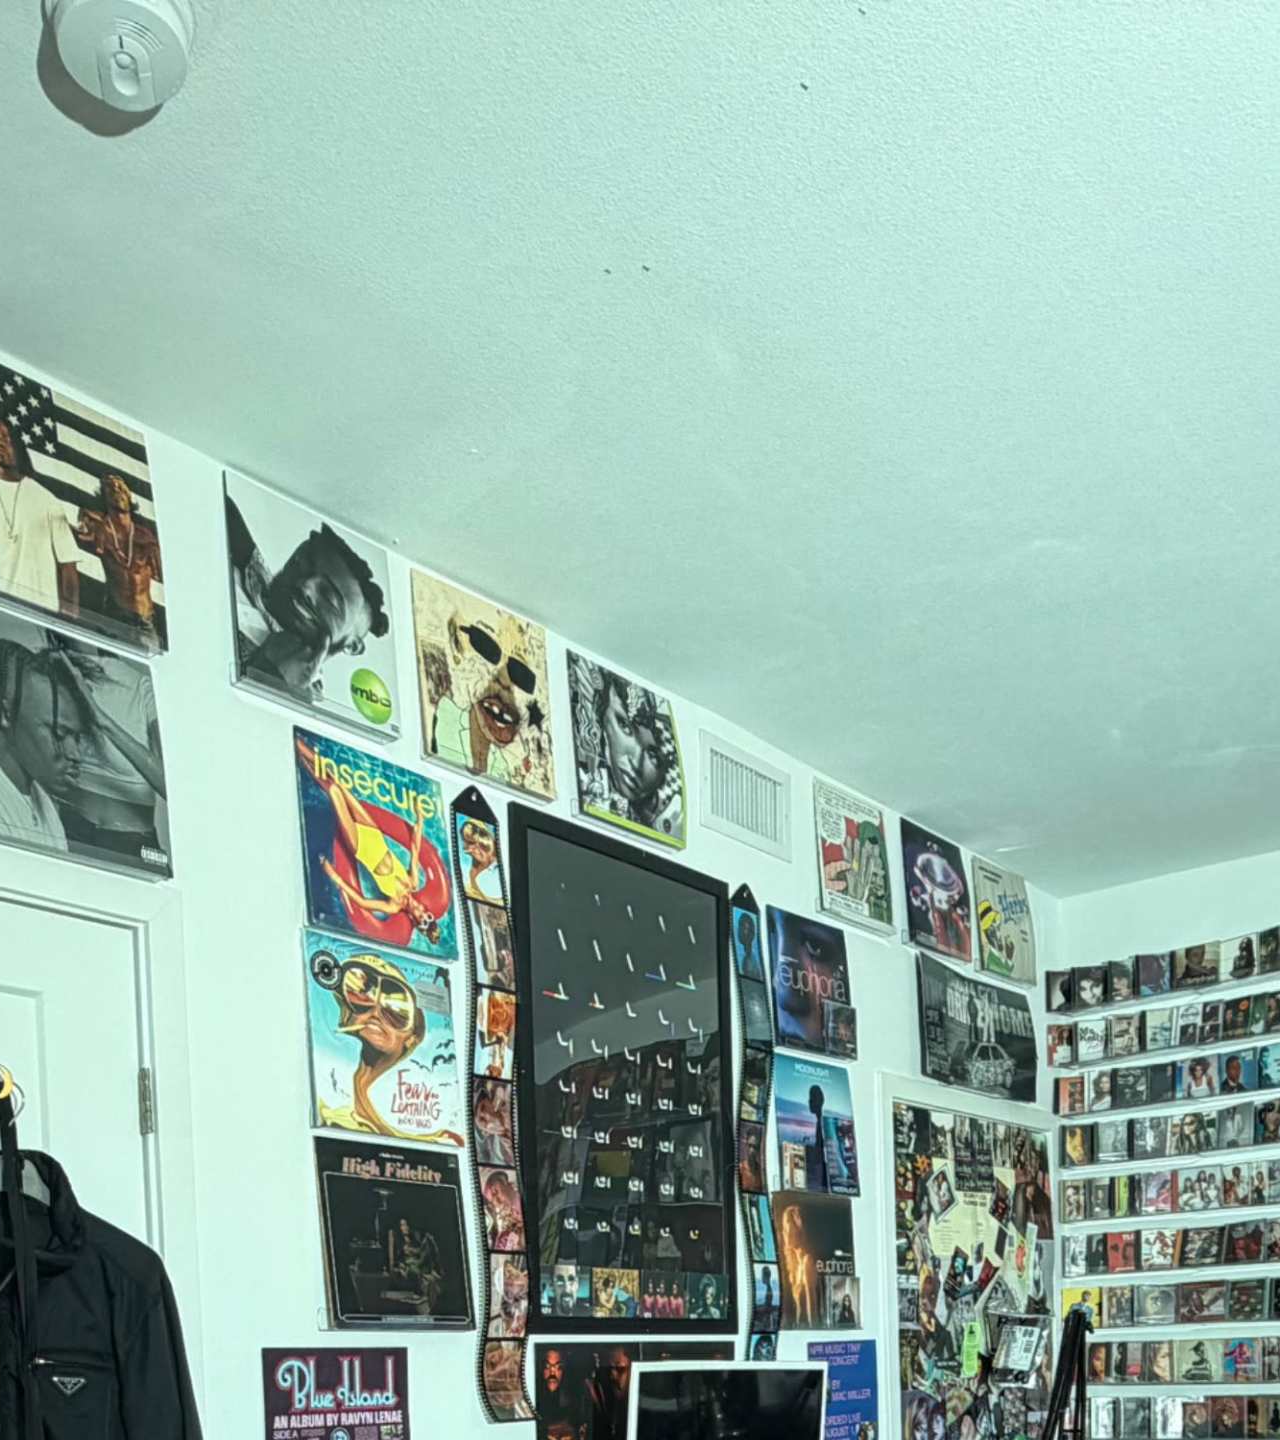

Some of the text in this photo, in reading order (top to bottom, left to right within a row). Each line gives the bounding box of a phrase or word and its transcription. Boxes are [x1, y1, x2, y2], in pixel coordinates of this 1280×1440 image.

[313, 747, 437, 818] insecure
[341, 1156, 443, 1185] High Fidelity
[276, 1357, 397, 1410] Blue Island
[273, 1414, 289, 1430] AN
[289, 1413, 325, 1429] ALBUM
[326, 1412, 340, 1427] BY
